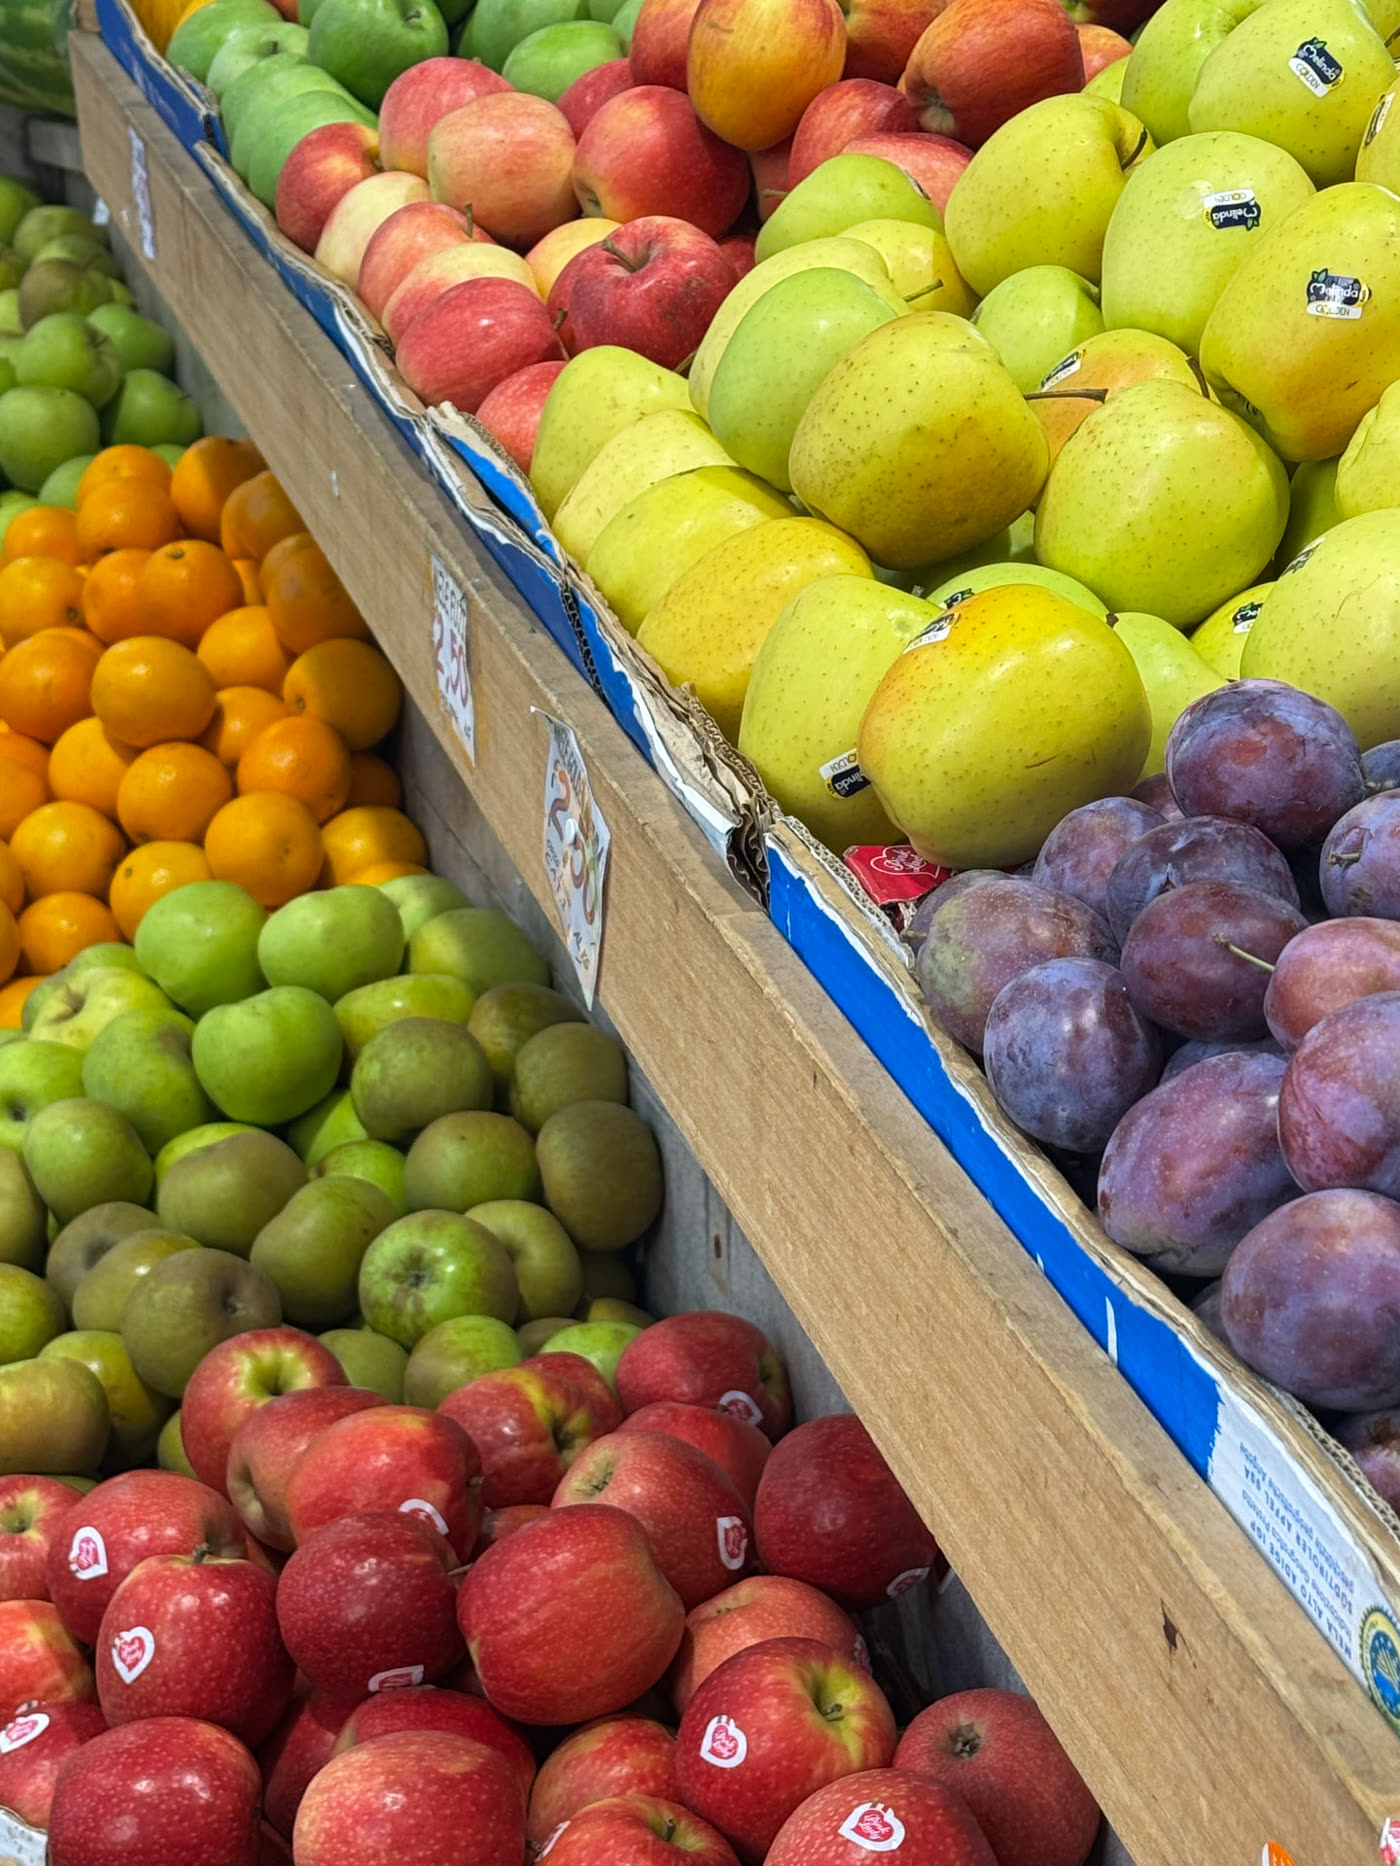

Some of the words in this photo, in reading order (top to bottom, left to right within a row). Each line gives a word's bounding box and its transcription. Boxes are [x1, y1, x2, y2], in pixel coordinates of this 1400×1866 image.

[1303, 44, 1337, 81] Melinda
[1212, 206, 1258, 223] Melinda
[1310, 282, 1359, 298] Melinda
[1270, 1541, 1296, 1584] ADIGE
[1300, 1584, 1323, 1619] ALTO
[862, 1813, 891, 1833] Pink
